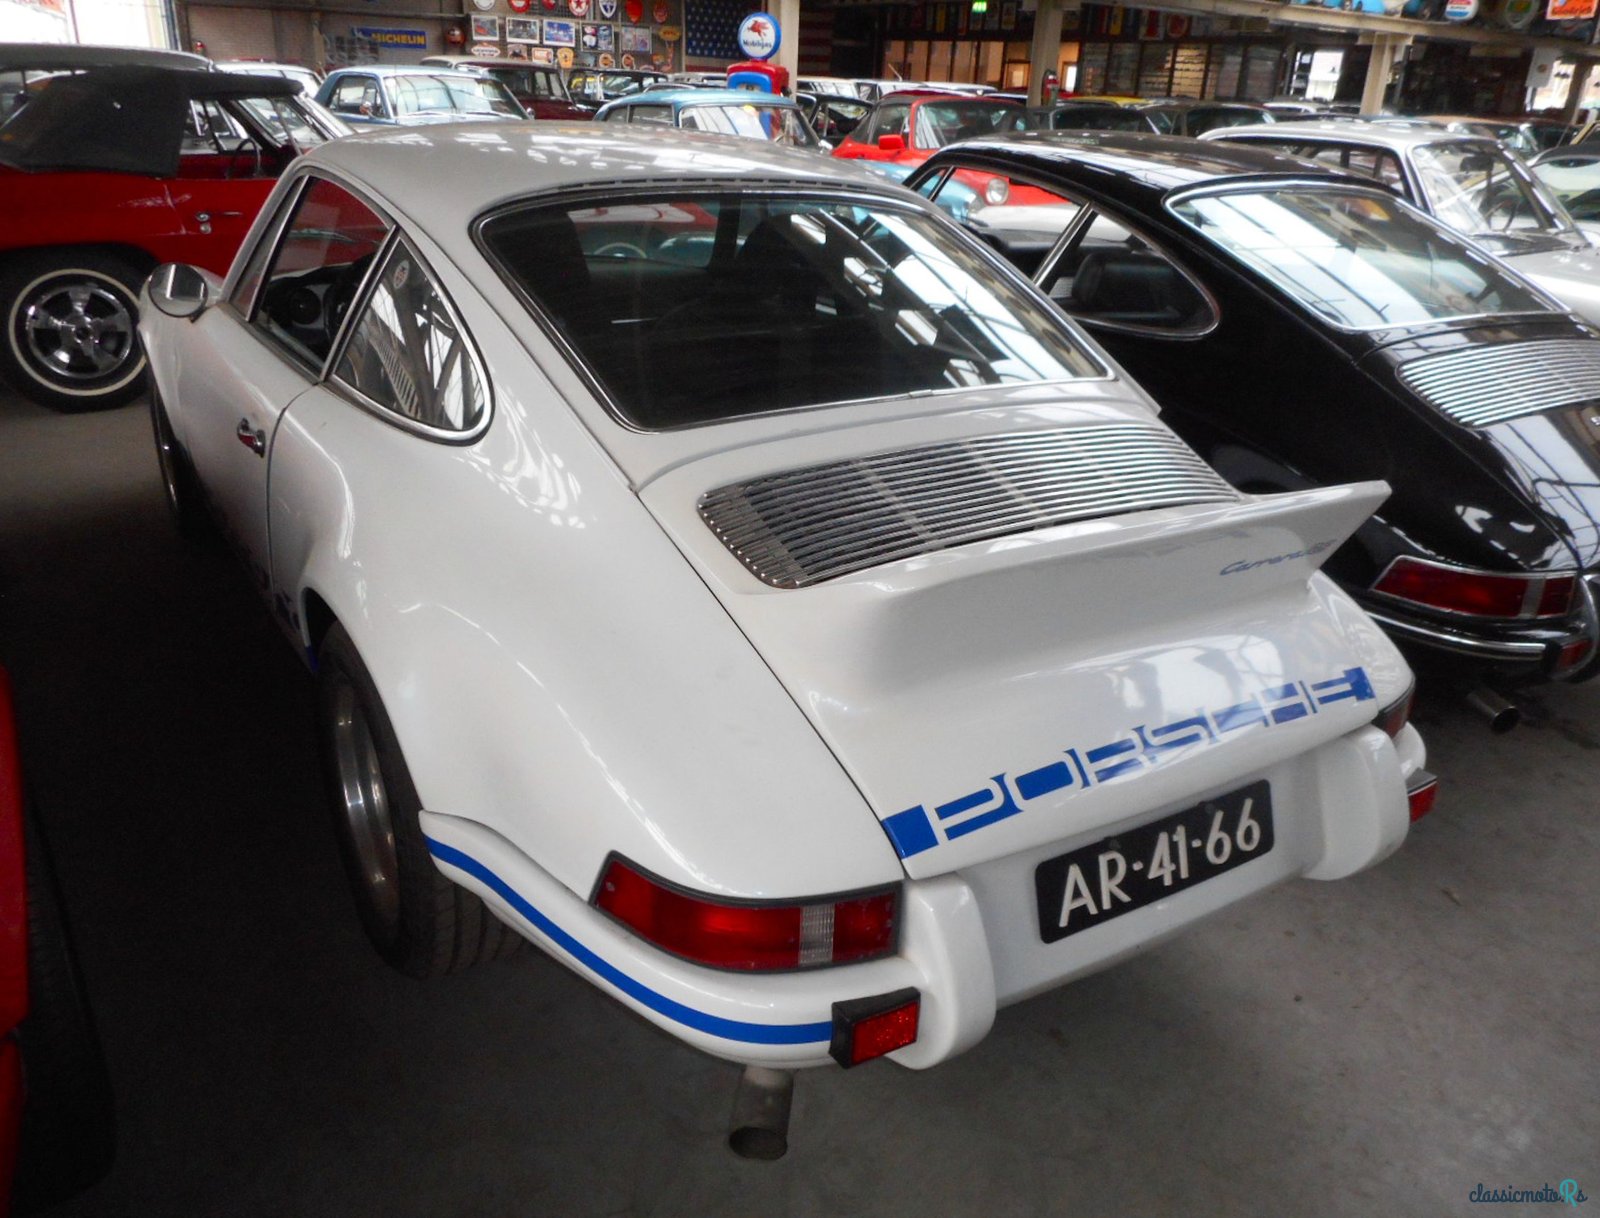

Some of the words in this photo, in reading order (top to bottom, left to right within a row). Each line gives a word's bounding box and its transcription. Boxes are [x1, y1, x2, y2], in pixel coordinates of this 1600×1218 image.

[371, 32, 426, 45] MICHELIN
[905, 668, 1376, 844] PORSCHE
[1057, 797, 1263, 929] AR-41-66
